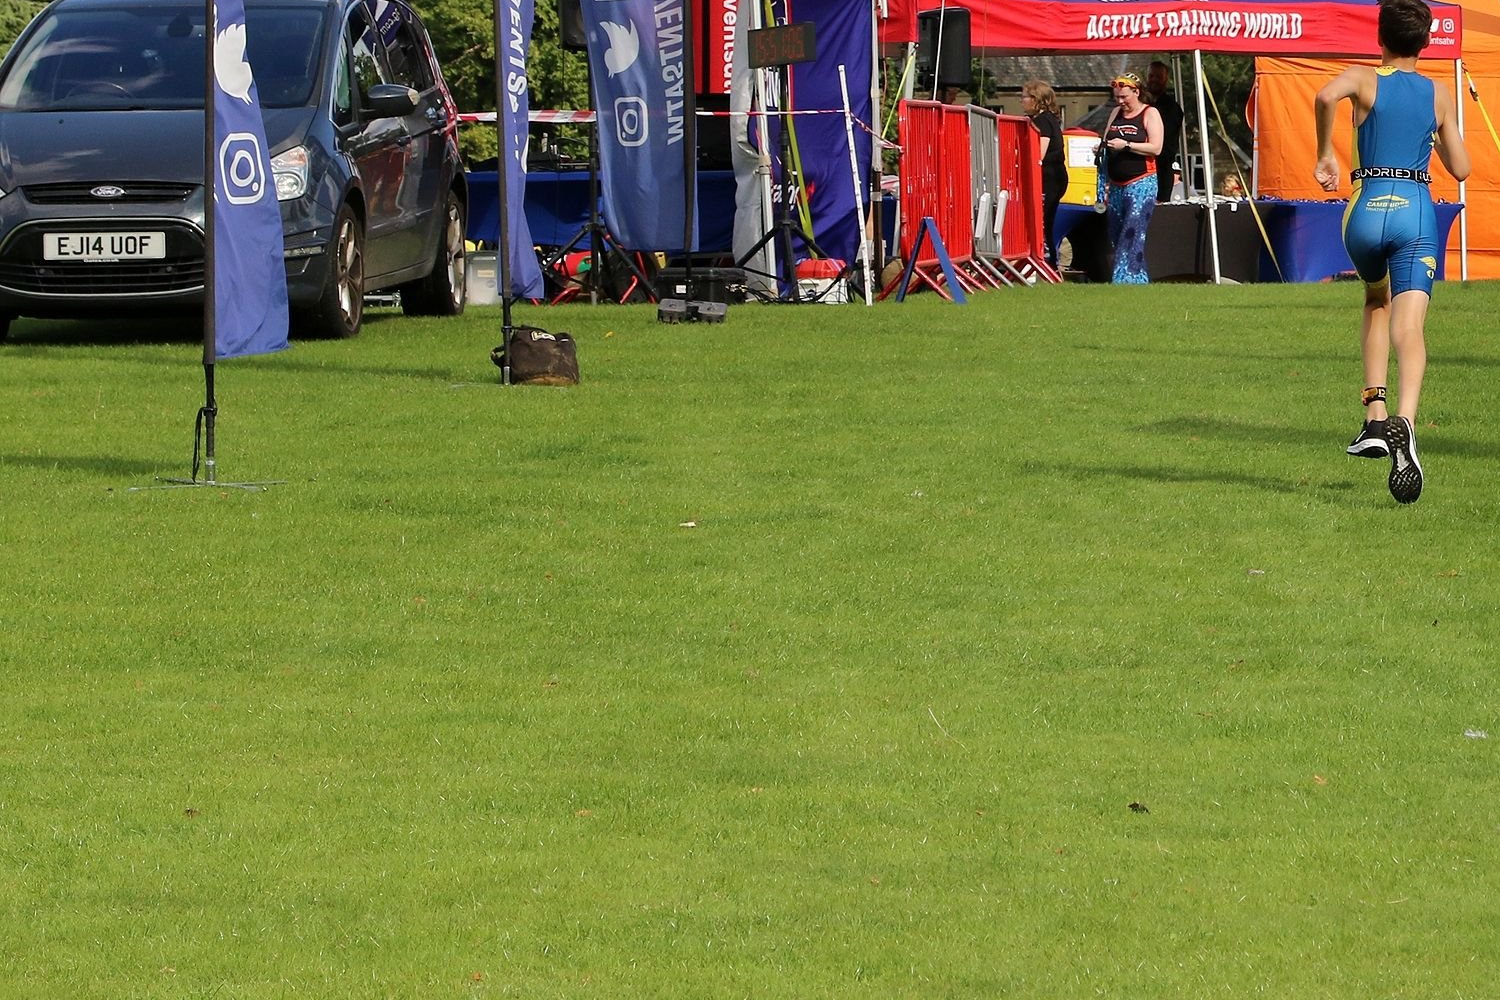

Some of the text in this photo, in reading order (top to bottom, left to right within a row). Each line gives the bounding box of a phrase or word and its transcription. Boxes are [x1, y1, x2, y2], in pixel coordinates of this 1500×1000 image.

[1087, 10, 1303, 40] ACTIVE TRAINING WORLD
[1354, 167, 1411, 179] SUNDRIED
[57, 236, 151, 256] EJ14 UOF
